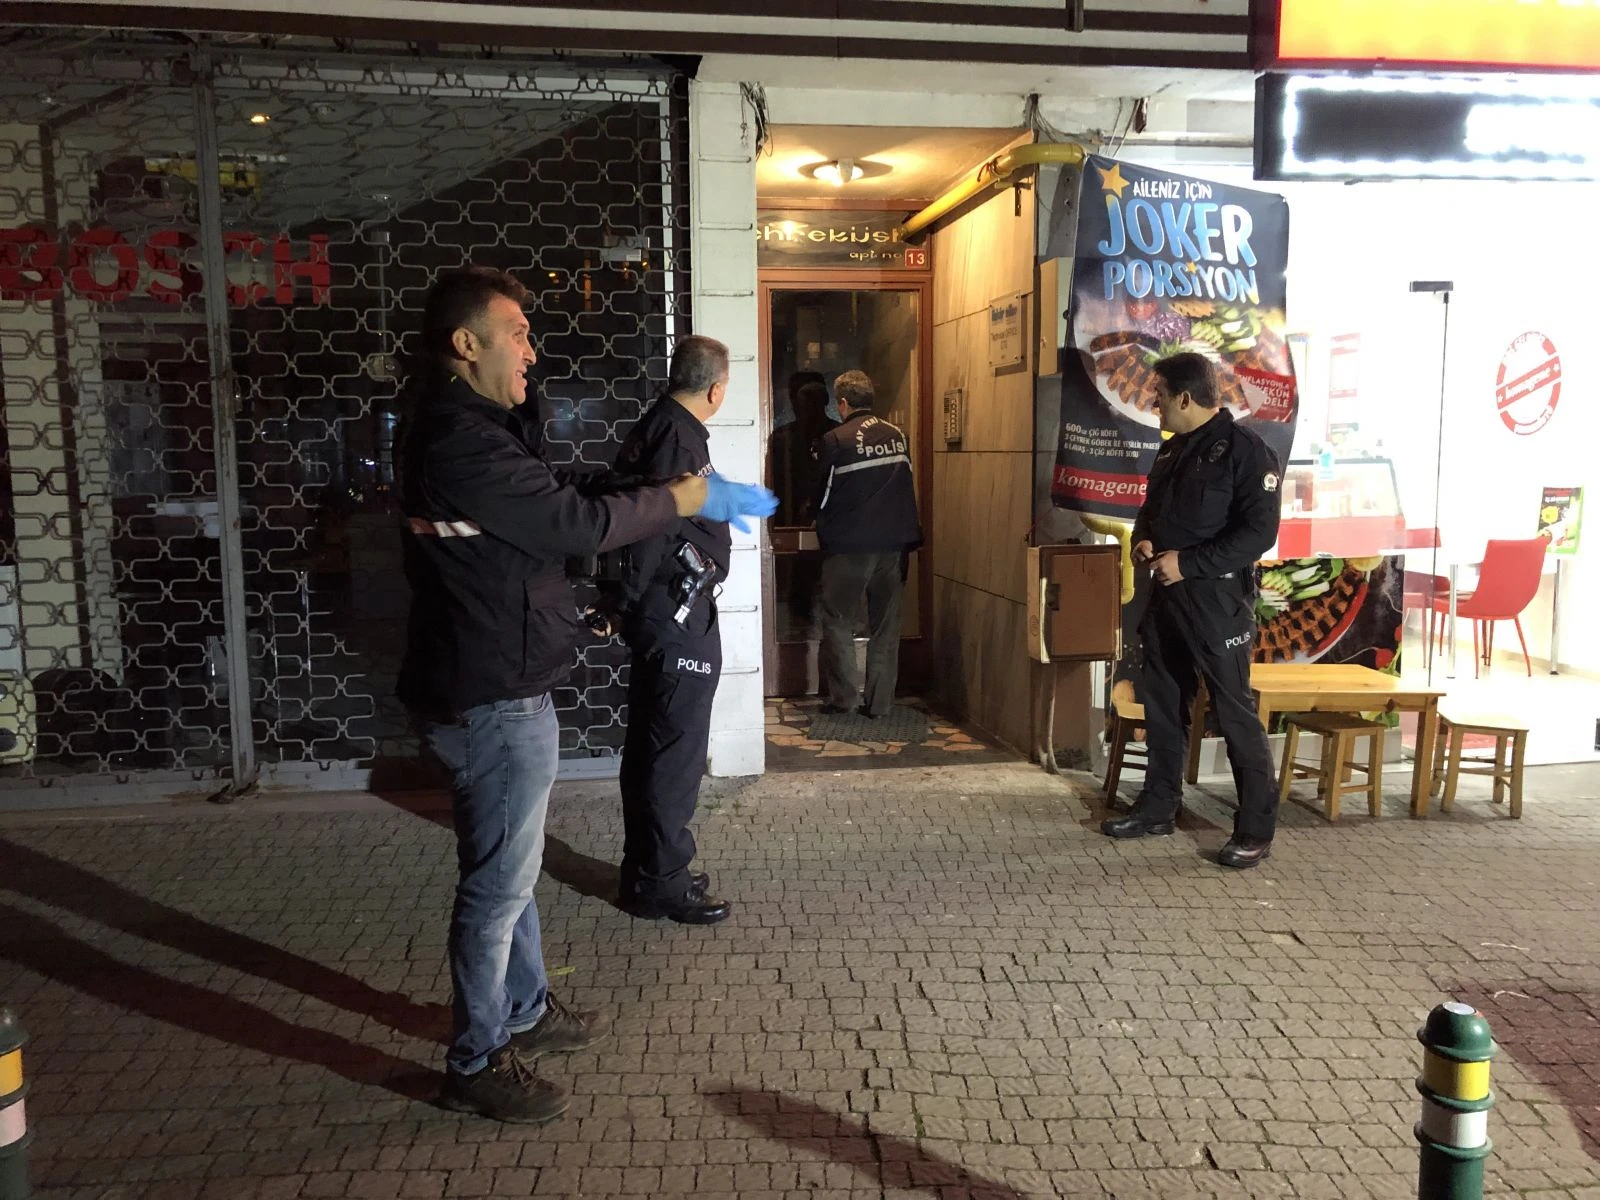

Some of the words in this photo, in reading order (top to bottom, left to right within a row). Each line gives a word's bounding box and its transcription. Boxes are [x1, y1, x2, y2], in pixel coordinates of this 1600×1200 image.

[1133, 178, 1180, 199] AİLENİZ
[1185, 180, 1213, 202] İÇİN
[1098, 194, 1258, 267] JOKER
[0, 228, 330, 305] BOSCH
[908, 253, 925, 265] 13
[1264, 396, 1289, 408] DELE
[865, 439, 905, 458] POLİS
[1057, 468, 1147, 498] komagene
